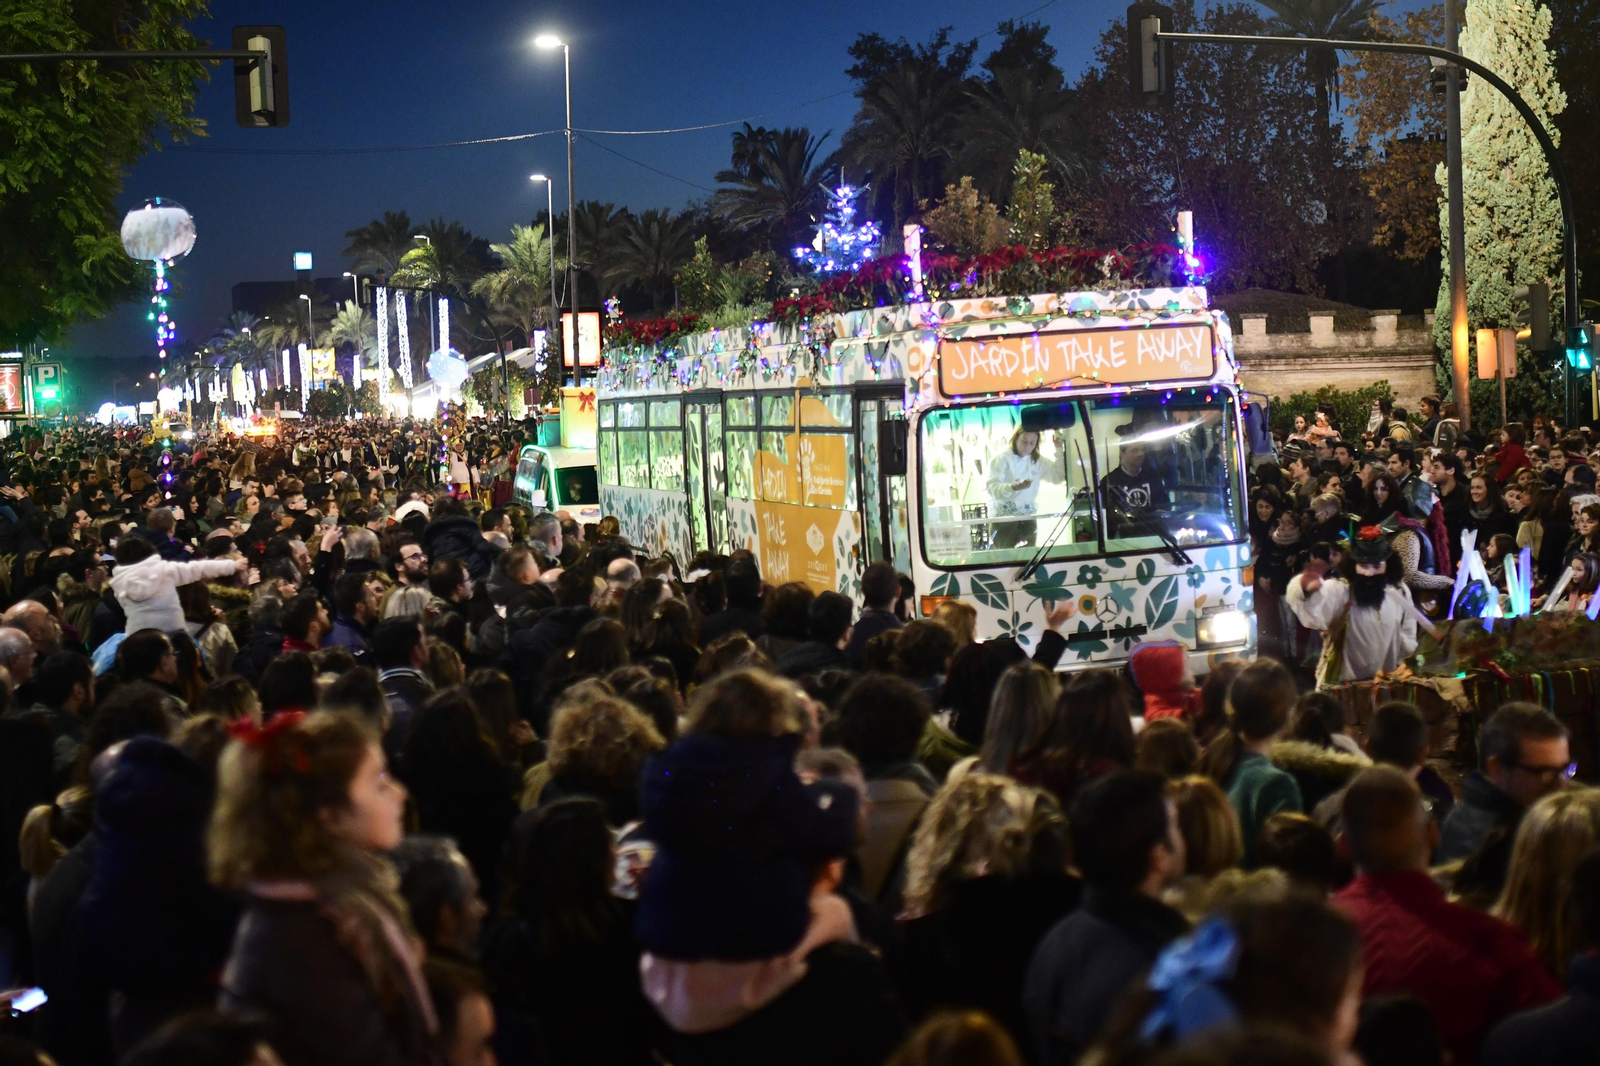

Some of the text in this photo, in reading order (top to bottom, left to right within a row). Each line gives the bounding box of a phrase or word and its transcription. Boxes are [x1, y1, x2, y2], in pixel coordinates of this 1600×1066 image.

[1057, 336, 1127, 372] TAKE
[1138, 328, 1204, 365] AWAY
[38, 366, 55, 385] P
[763, 511, 787, 546] TAKE
[767, 548, 789, 582] AWAY
